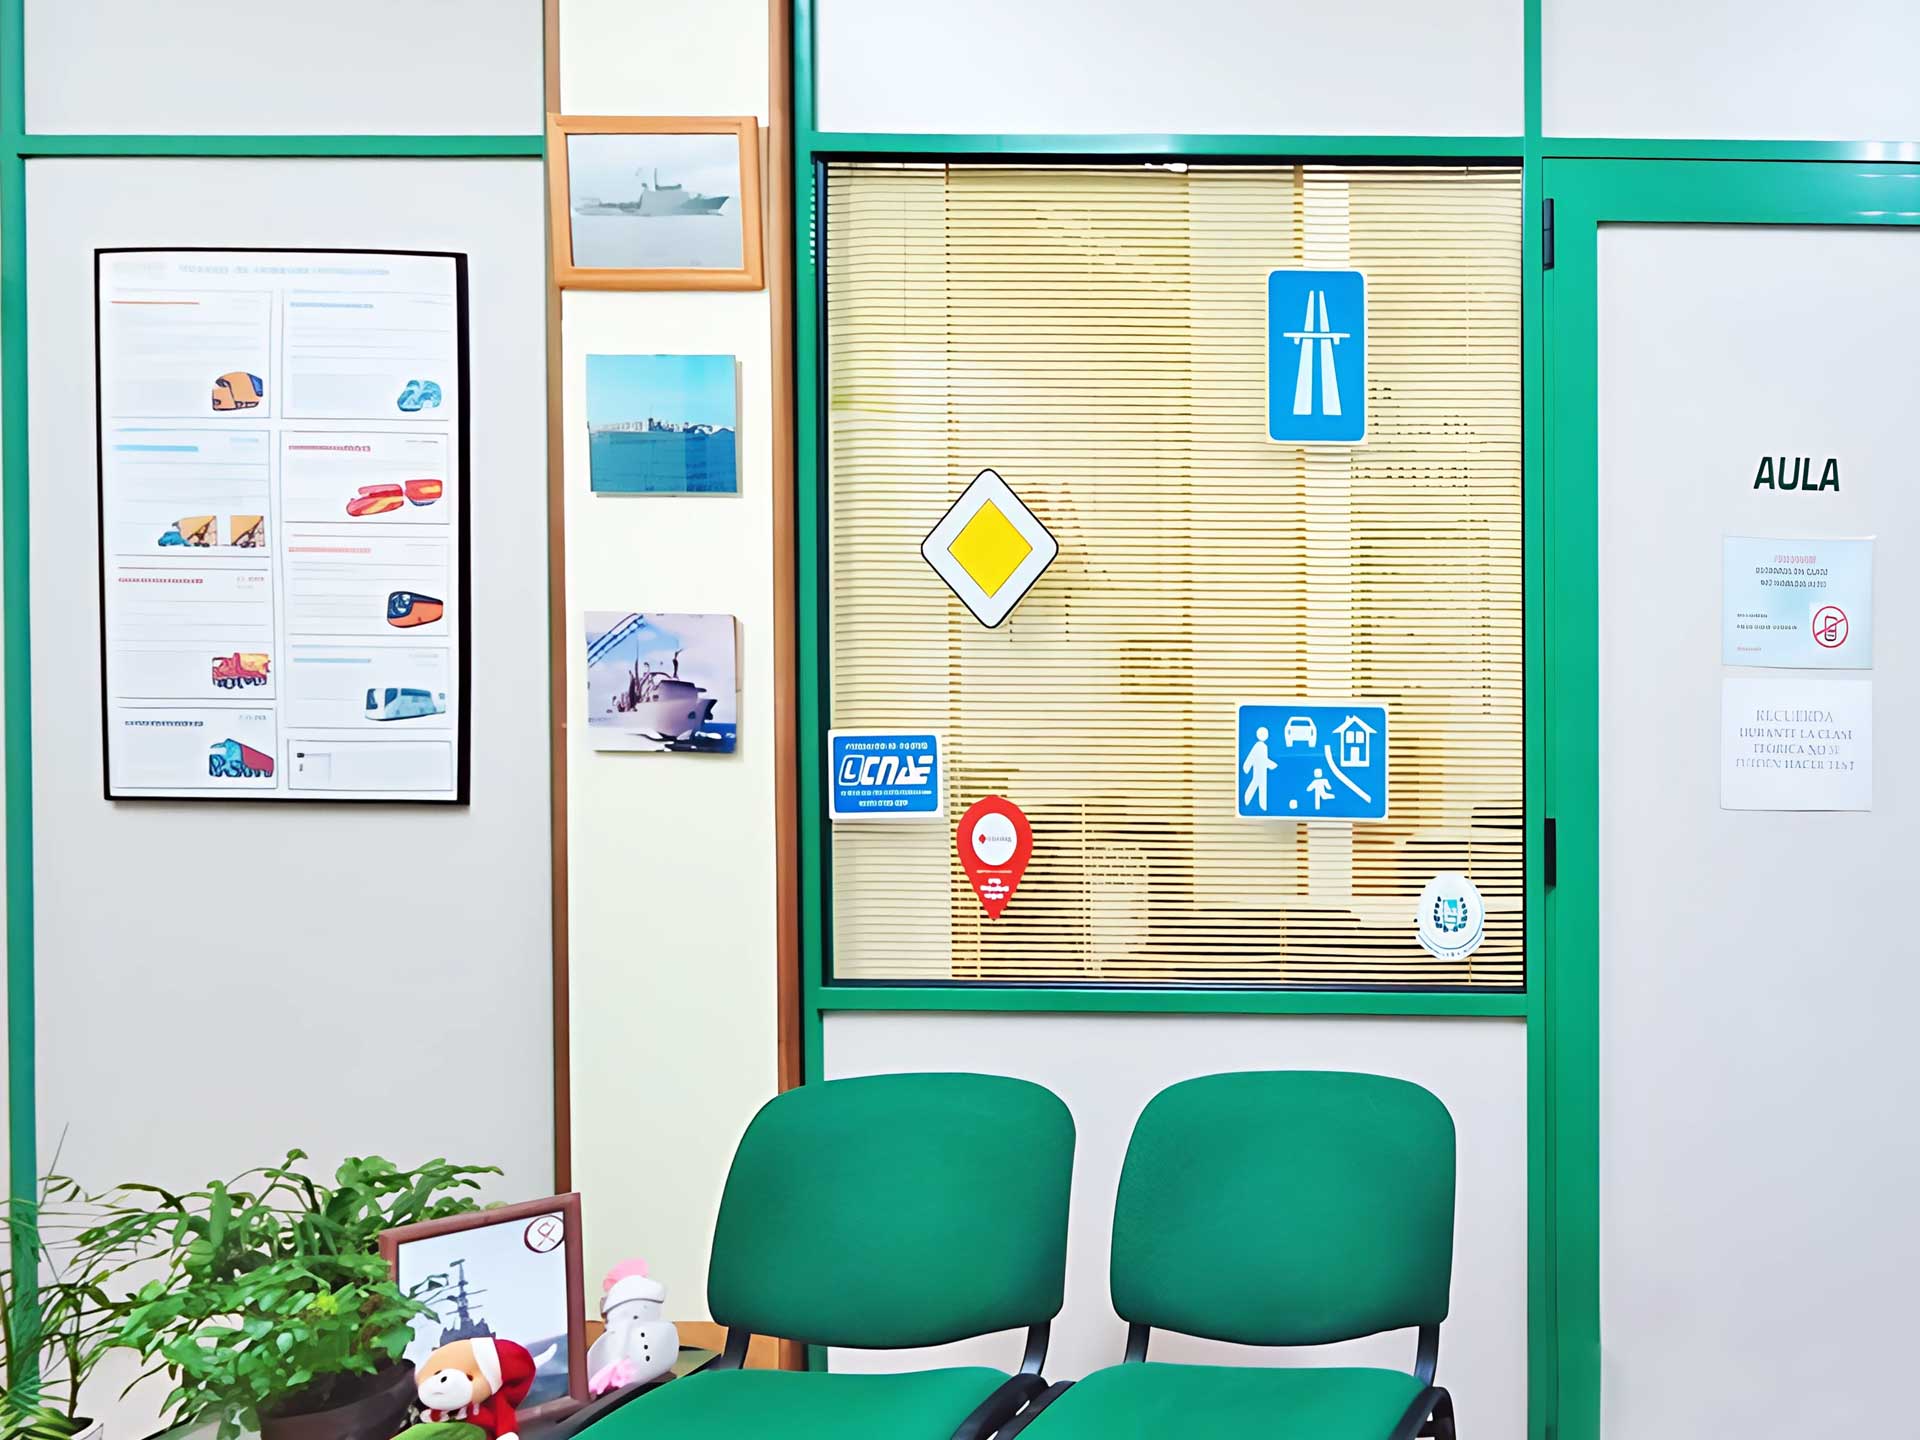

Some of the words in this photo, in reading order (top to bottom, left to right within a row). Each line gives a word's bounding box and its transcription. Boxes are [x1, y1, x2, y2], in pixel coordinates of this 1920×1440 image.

[1753, 456, 1840, 491] AULA
[1756, 709, 1833, 722] RECUERDA
[1739, 727, 1796, 739] DURANTE
[1800, 728, 1815, 739] LA
[1807, 744, 1826, 756] NO
